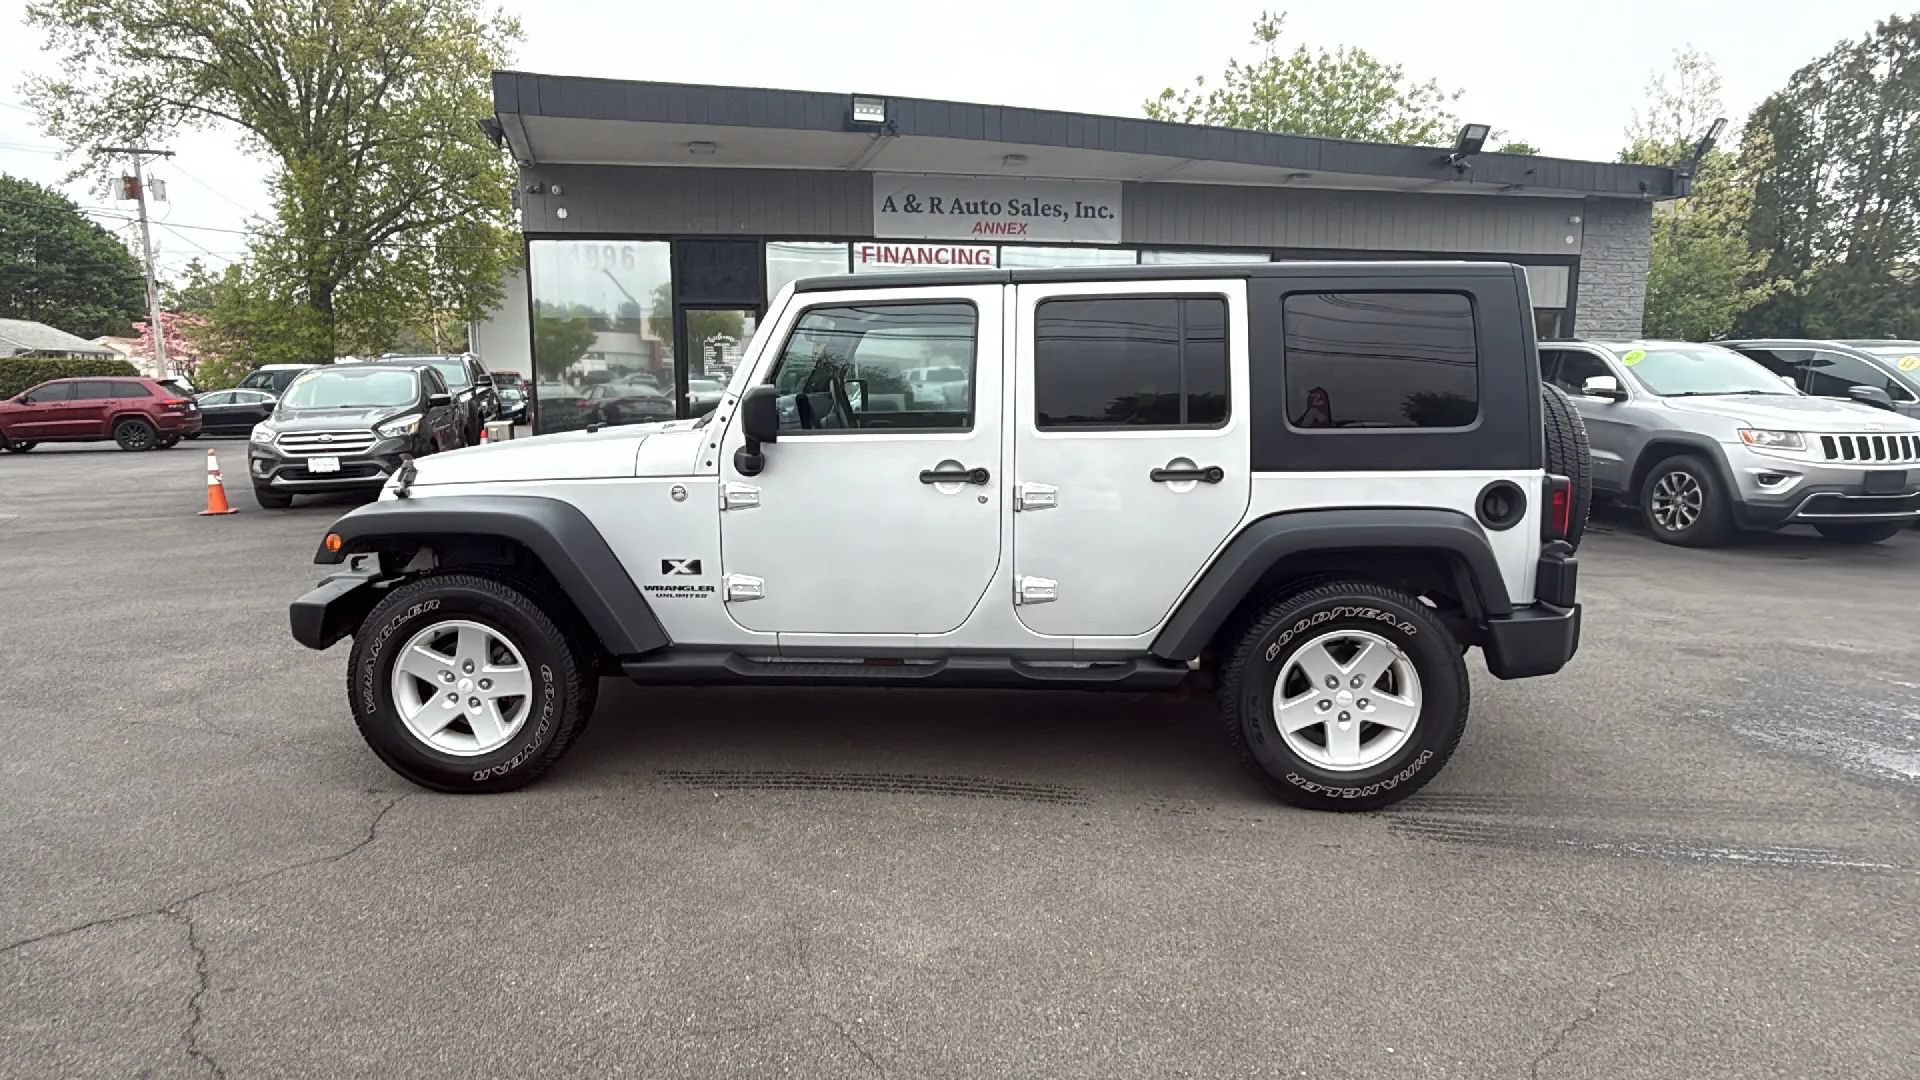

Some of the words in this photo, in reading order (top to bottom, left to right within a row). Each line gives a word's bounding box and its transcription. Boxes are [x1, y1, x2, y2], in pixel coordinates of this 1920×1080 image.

[881, 195, 898, 213] A
[903, 193, 924, 214] &
[929, 196, 945, 215] R
[950, 197, 1002, 216] Auto
[1007, 197, 1069, 222] Sales,
[1075, 201, 1115, 219] Inc.
[971, 221, 1028, 235] ANNEX
[861, 245, 991, 265] FINANCING
[360, 599, 441, 715] WRANGLER
[1265, 606, 1417, 662] GOODYEAR
[472, 663, 555, 782] GOODYEAR
[1286, 750, 1433, 798] WRANGLER
